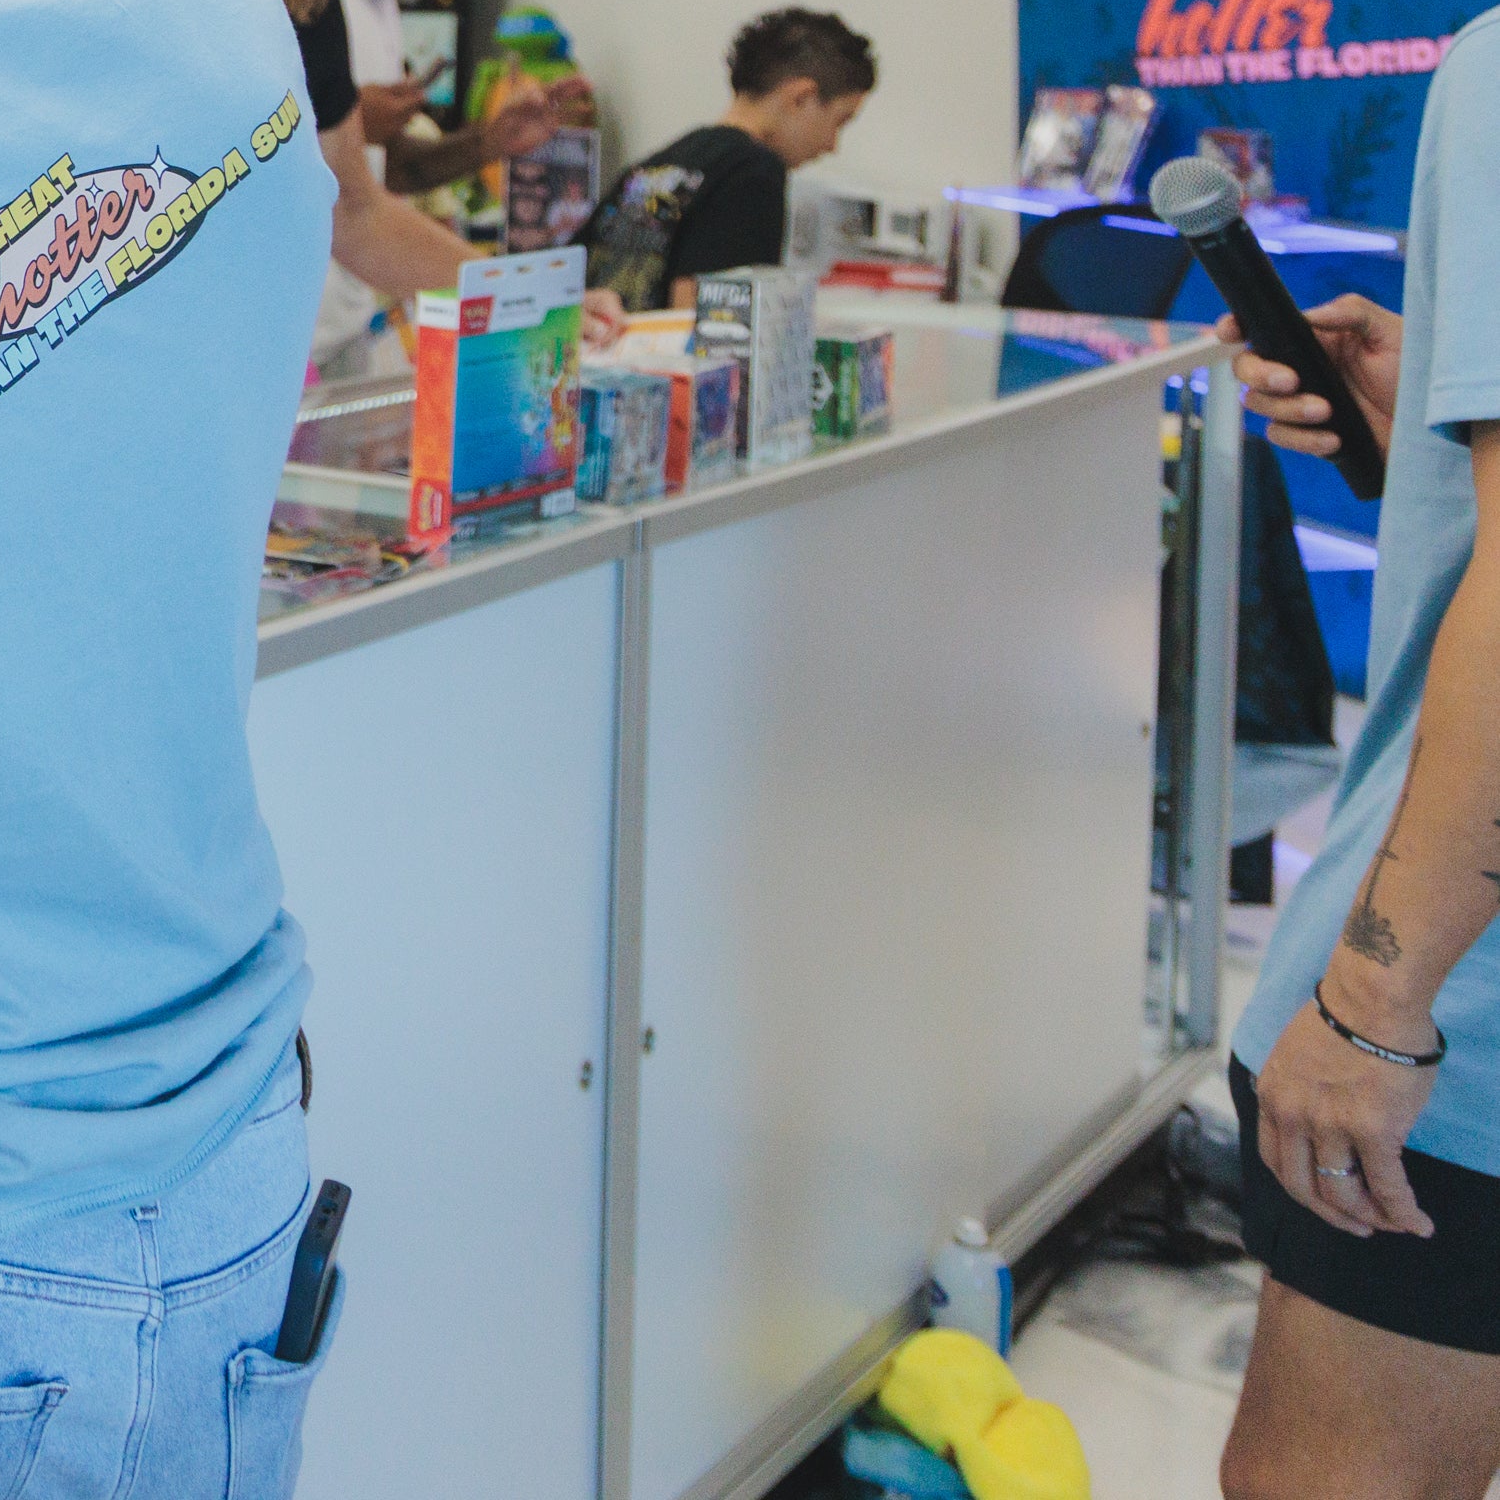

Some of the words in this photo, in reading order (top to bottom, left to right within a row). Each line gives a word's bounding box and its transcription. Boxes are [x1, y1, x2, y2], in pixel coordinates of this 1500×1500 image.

[1135, 53, 1225, 88] THAN
[1225, 49, 1293, 84] THE
[35, 270, 110, 350] THE
[106, 147, 251, 292] FLORIDA
[250, 88, 302, 163] SUN
